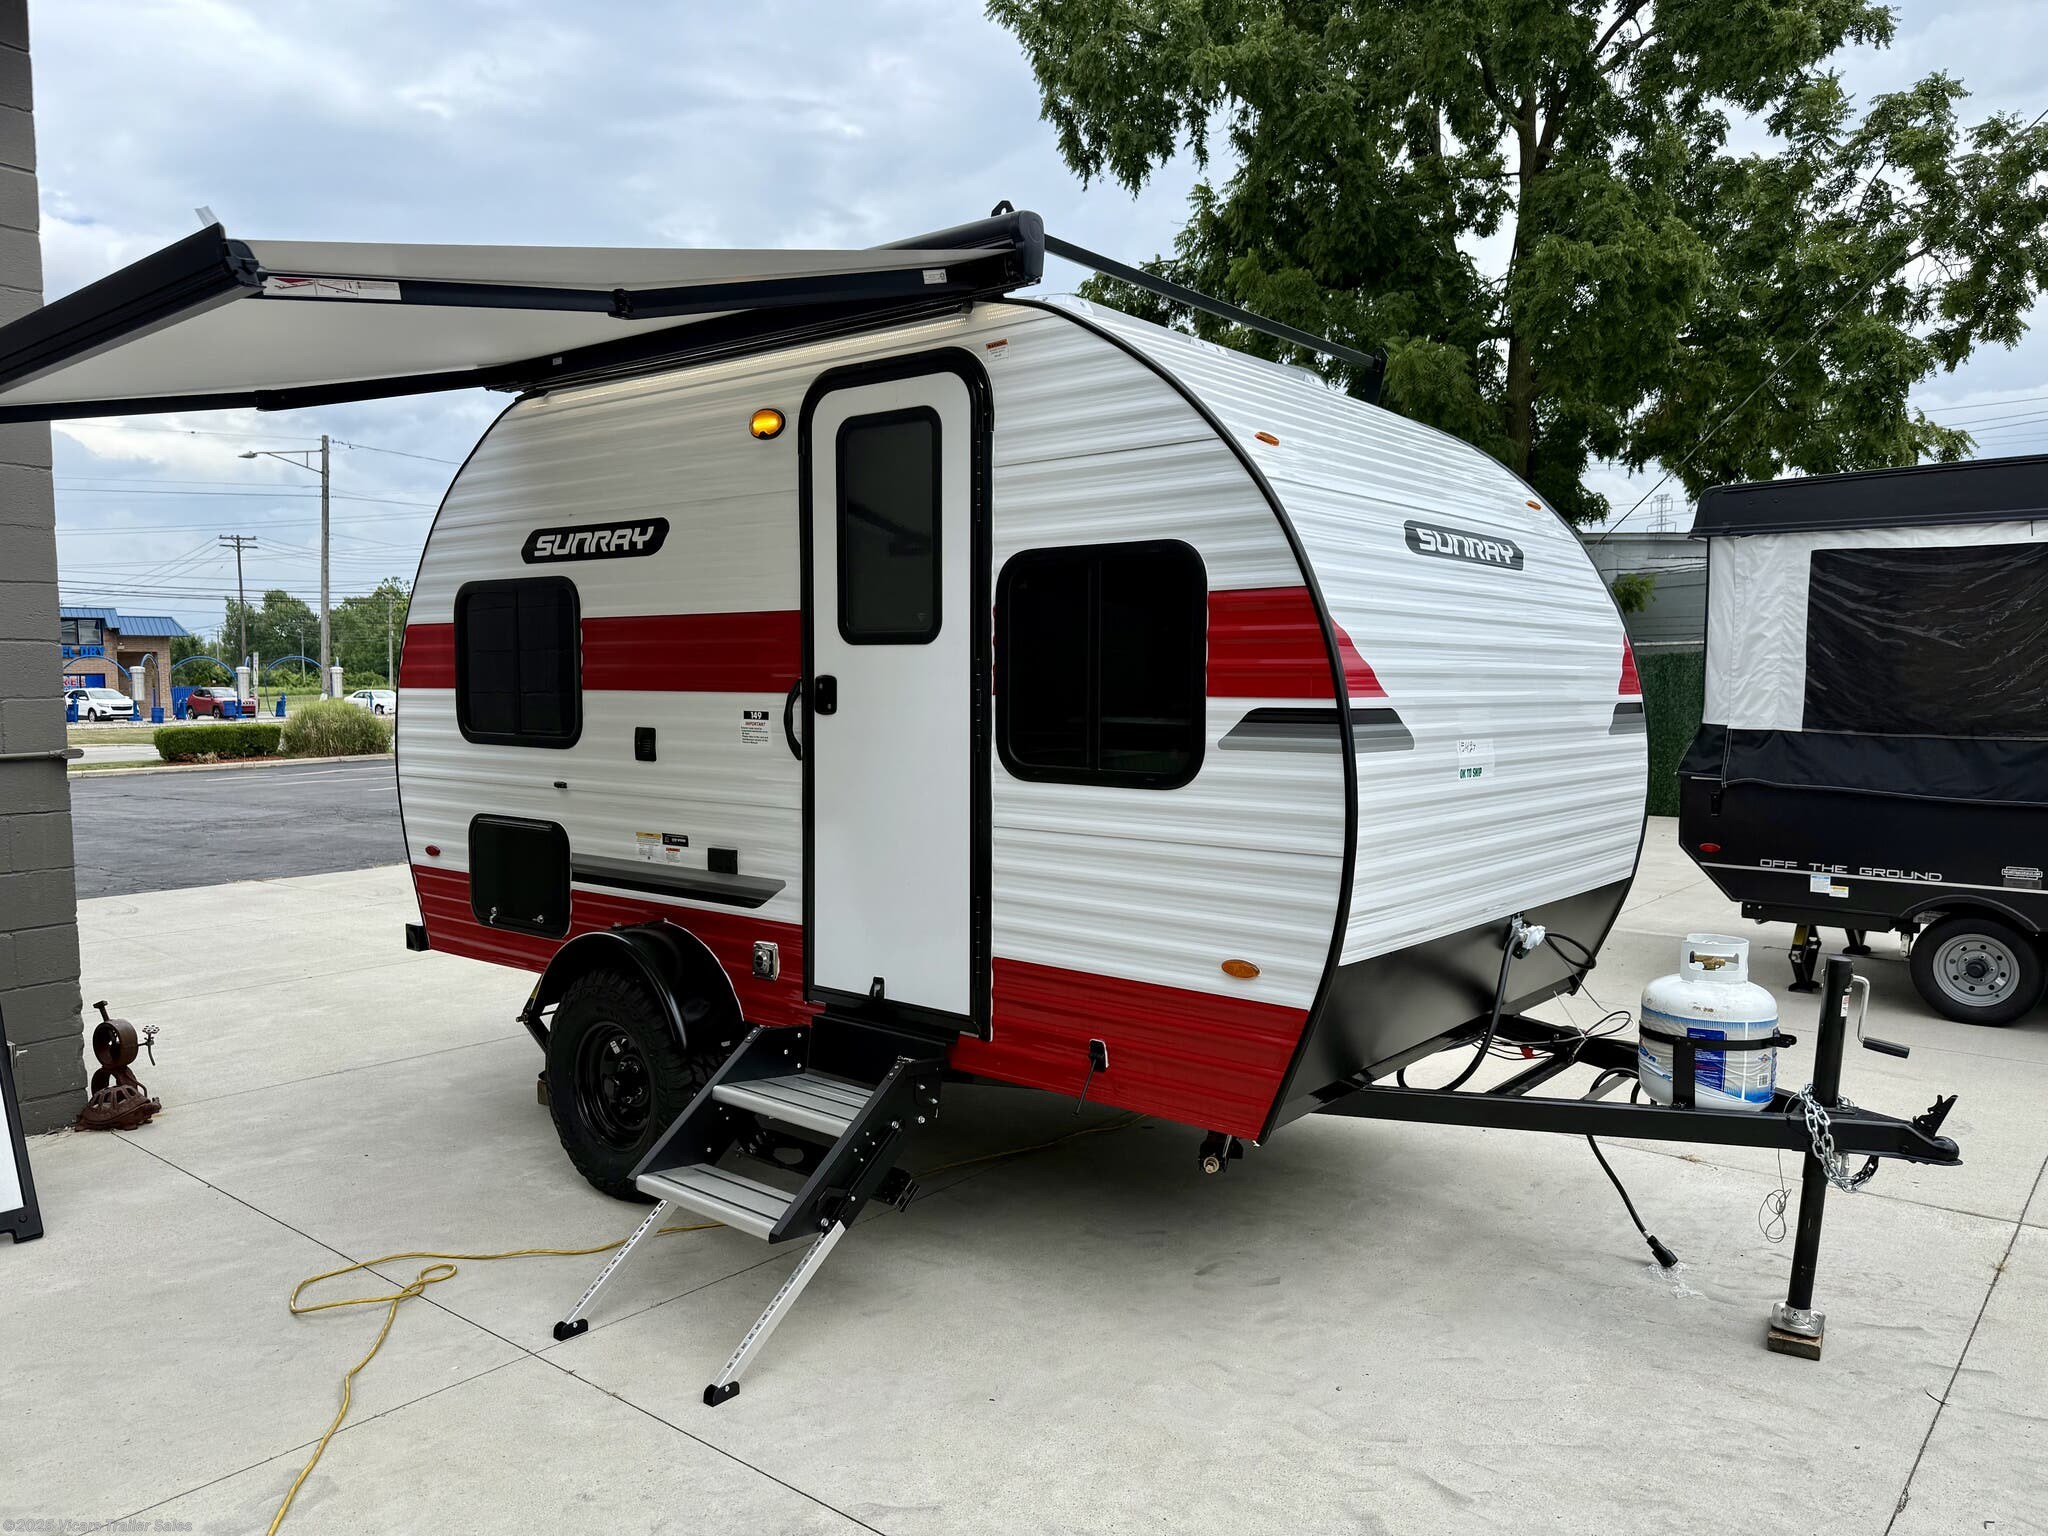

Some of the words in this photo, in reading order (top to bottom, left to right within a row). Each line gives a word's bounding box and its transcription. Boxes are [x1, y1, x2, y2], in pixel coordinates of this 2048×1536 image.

[534, 526, 655, 557] SUNRAY
[1416, 528, 1514, 564] SUNRAY
[750, 711, 762, 720] 149
[1759, 858, 1798, 869] OFF
[1808, 862, 1848, 874] THE
[1859, 867, 1943, 881] GROUND
